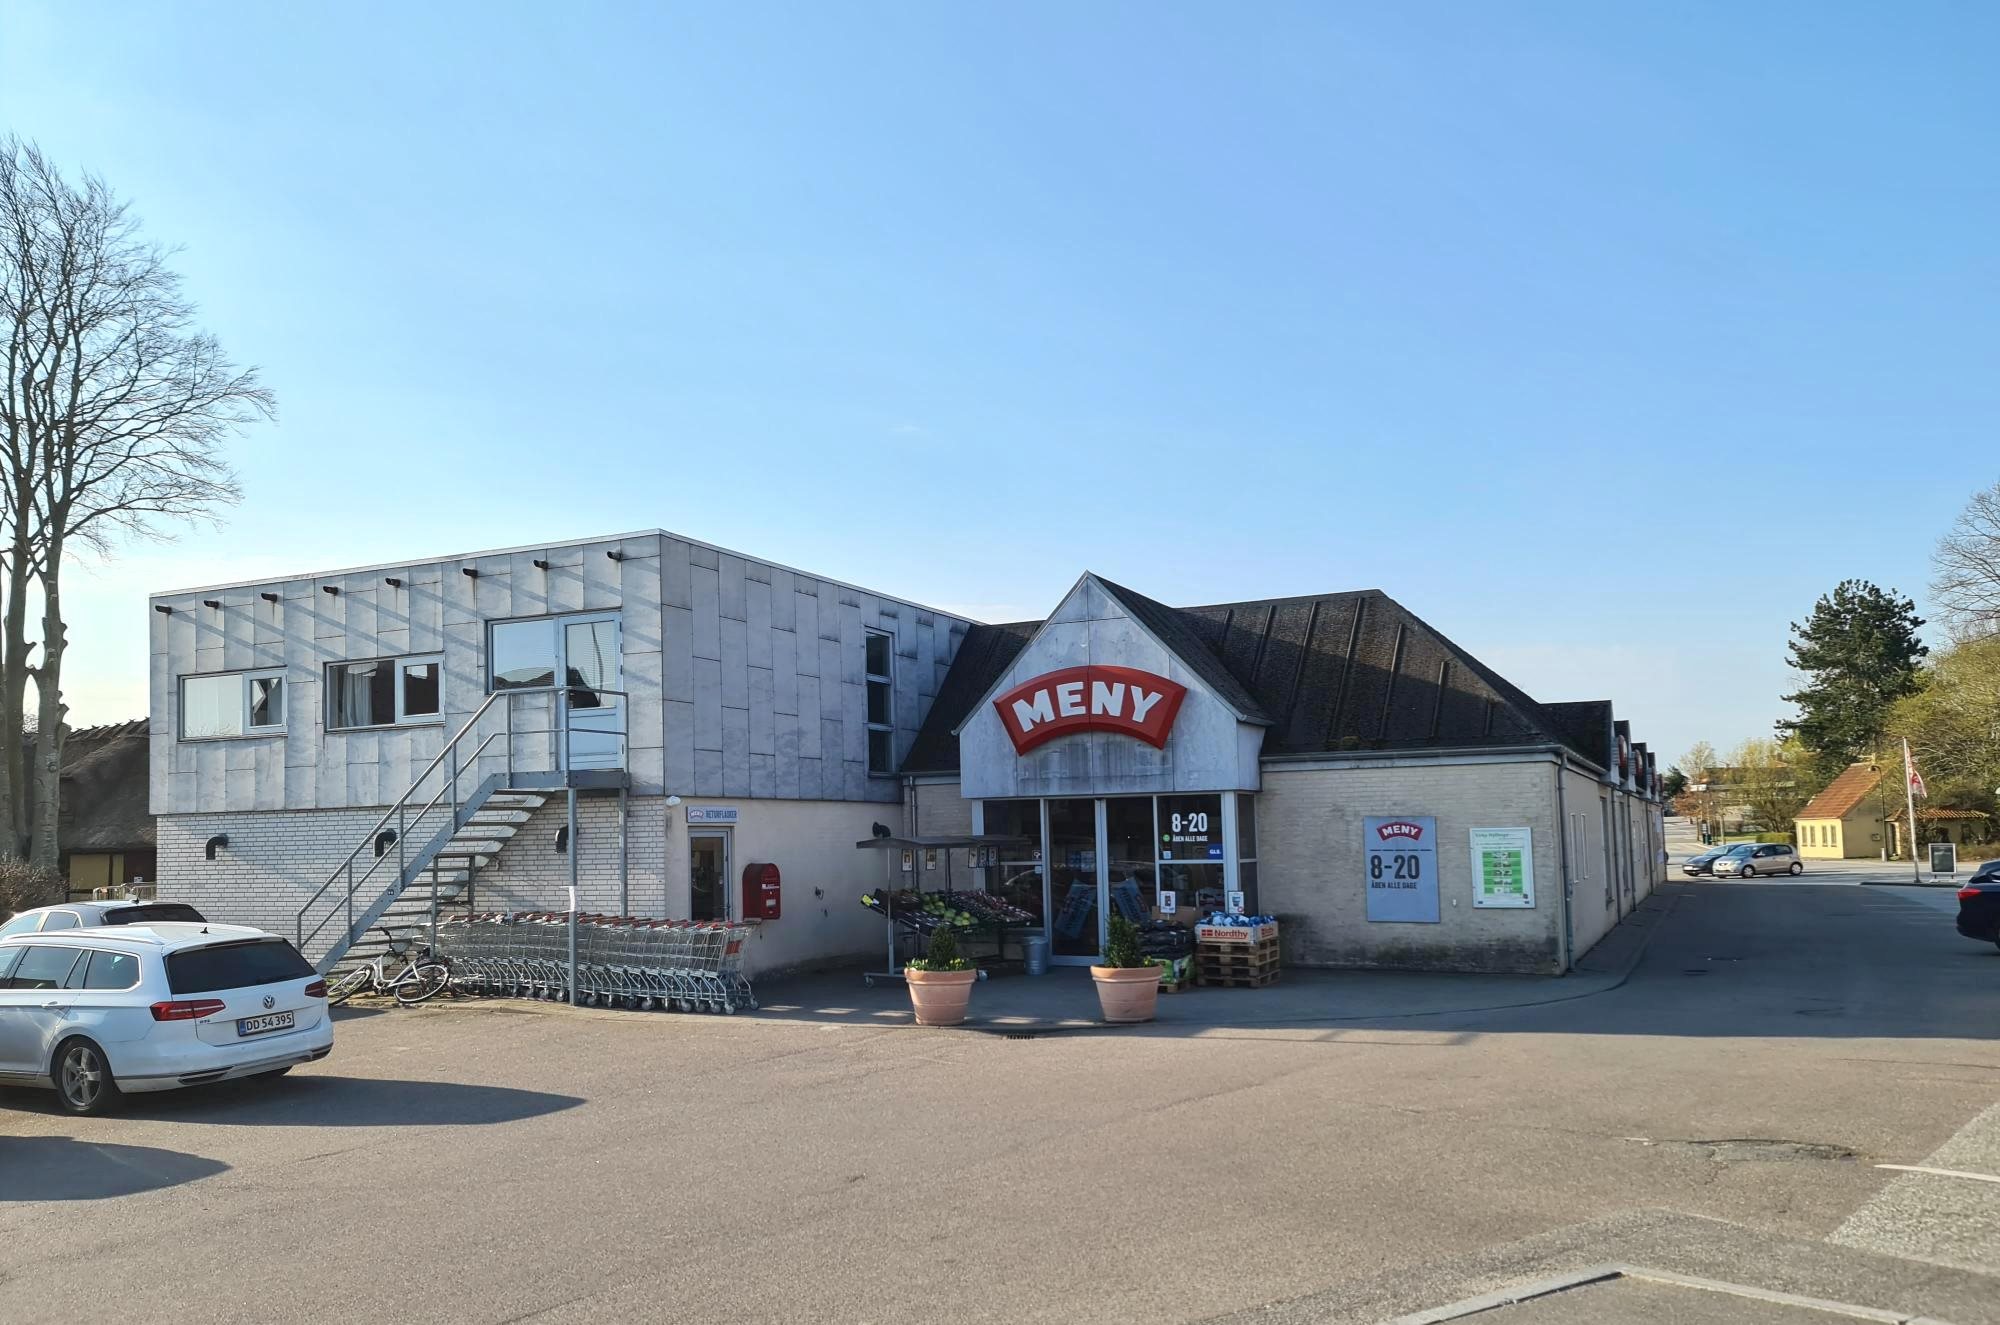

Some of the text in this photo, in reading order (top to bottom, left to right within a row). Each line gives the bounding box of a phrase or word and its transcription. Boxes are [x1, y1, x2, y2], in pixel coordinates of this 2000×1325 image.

[1011, 681, 1163, 733] MENY
[1171, 812, 1208, 833] 8-20
[1381, 825, 1419, 836] MENY
[1370, 854, 1420, 880] 8-20
[1371, 880, 1418, 890] ÅBEN ALLE DAGE
[1214, 929, 1249, 939] Nordthy
[246, 1013, 292, 1031] DD 54 395
